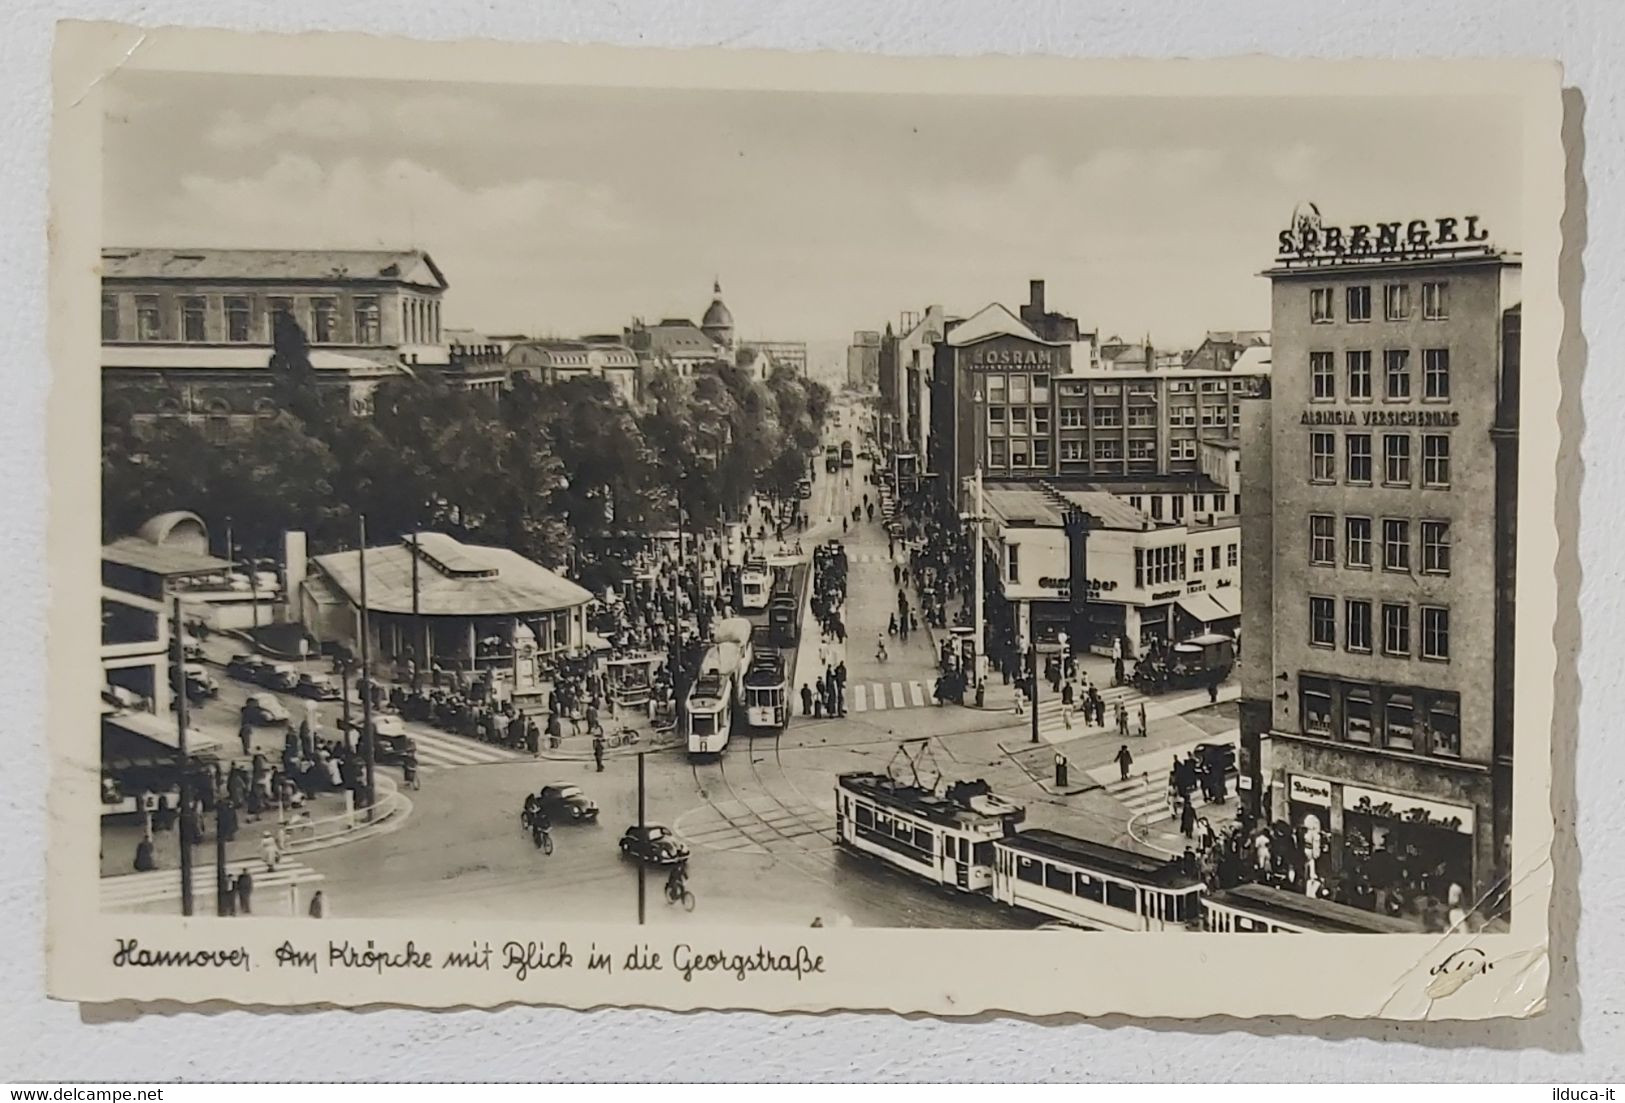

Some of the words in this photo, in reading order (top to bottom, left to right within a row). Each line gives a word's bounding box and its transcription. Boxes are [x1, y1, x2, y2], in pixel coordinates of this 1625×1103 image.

[1278, 215, 1489, 255] SPRENGEL
[986, 350, 1052, 365] OSRAM
[328, 939, 433, 975] Kröpcke
[442, 940, 493, 971] mit
[502, 941, 574, 981] Blick
[588, 942, 613, 975] in
[623, 944, 664, 971] die
[673, 943, 826, 982] Georgstraße
